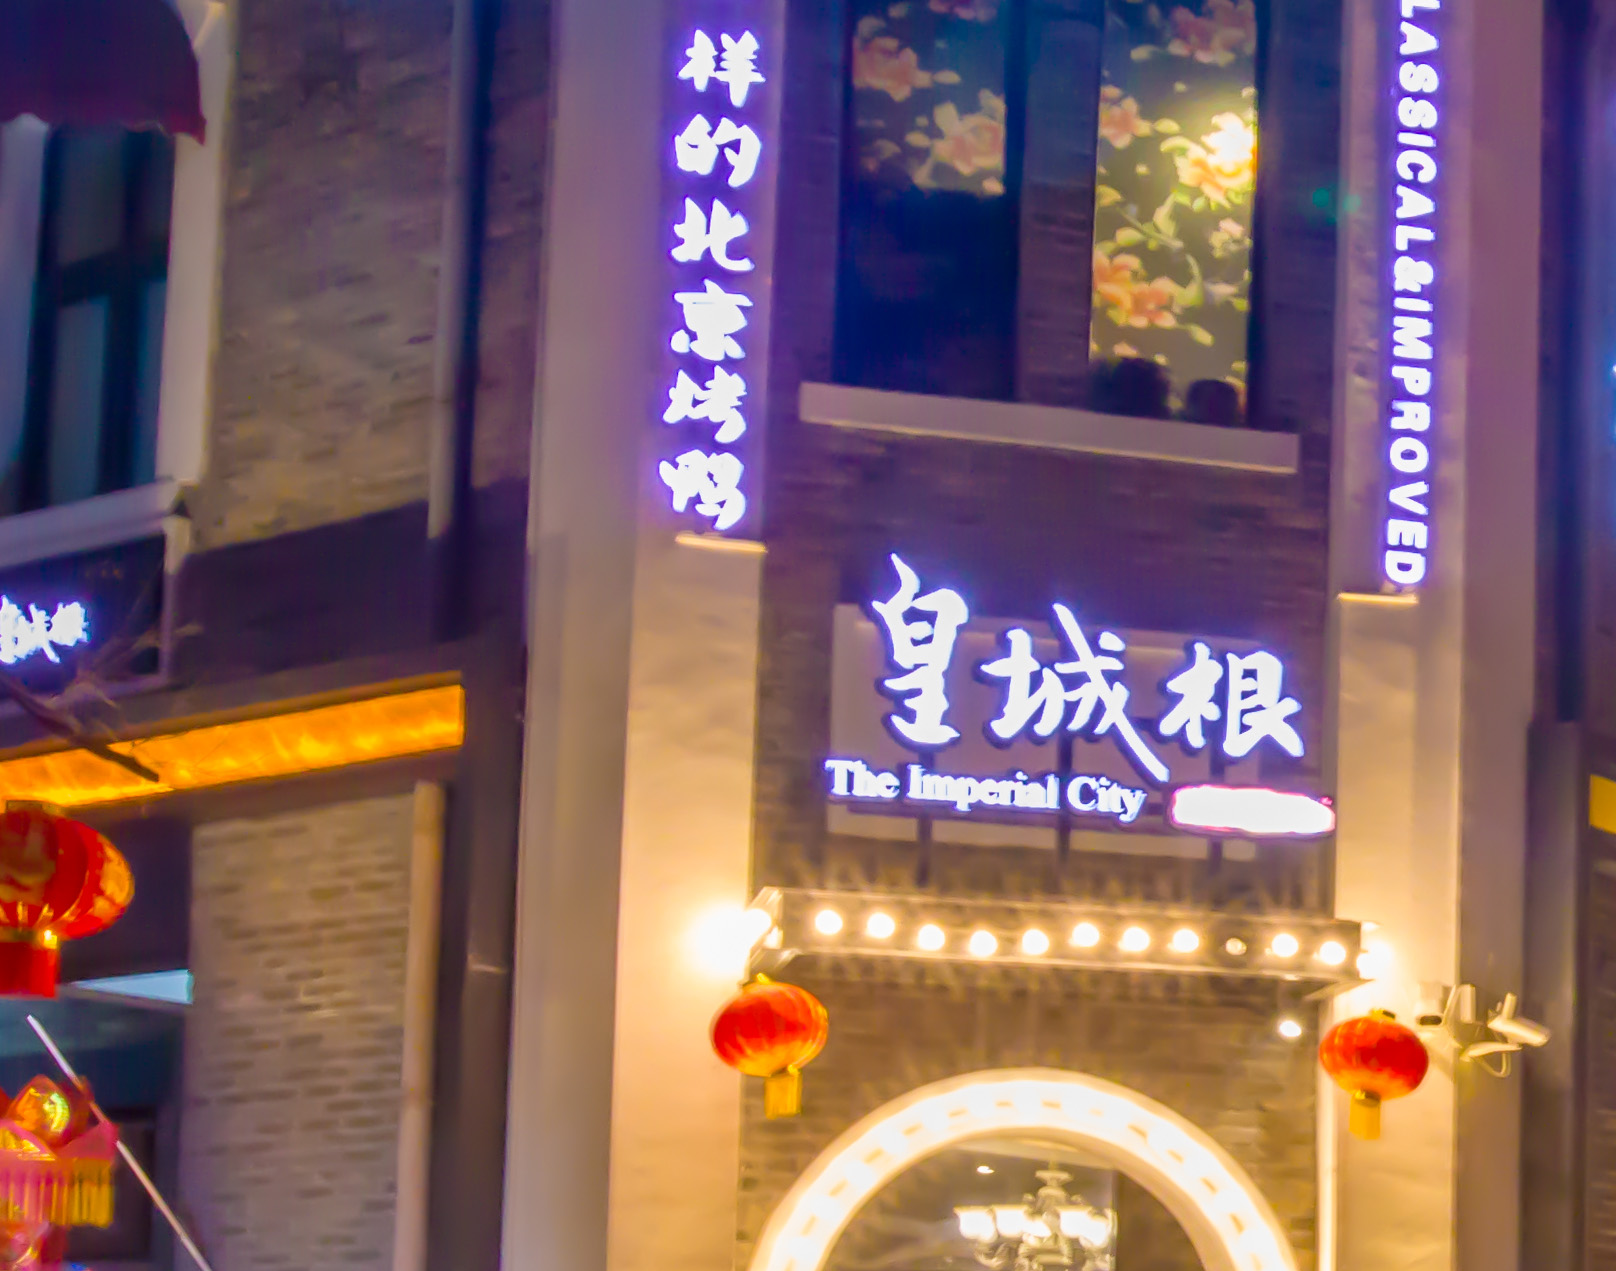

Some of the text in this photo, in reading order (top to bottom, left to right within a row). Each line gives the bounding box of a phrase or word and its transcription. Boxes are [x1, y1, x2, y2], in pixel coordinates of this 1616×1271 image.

[871, 552, 1305, 782] 皇城根
[824, 758, 900, 800] The
[906, 764, 1060, 812] Imperial
[1067, 776, 1148, 823] City
